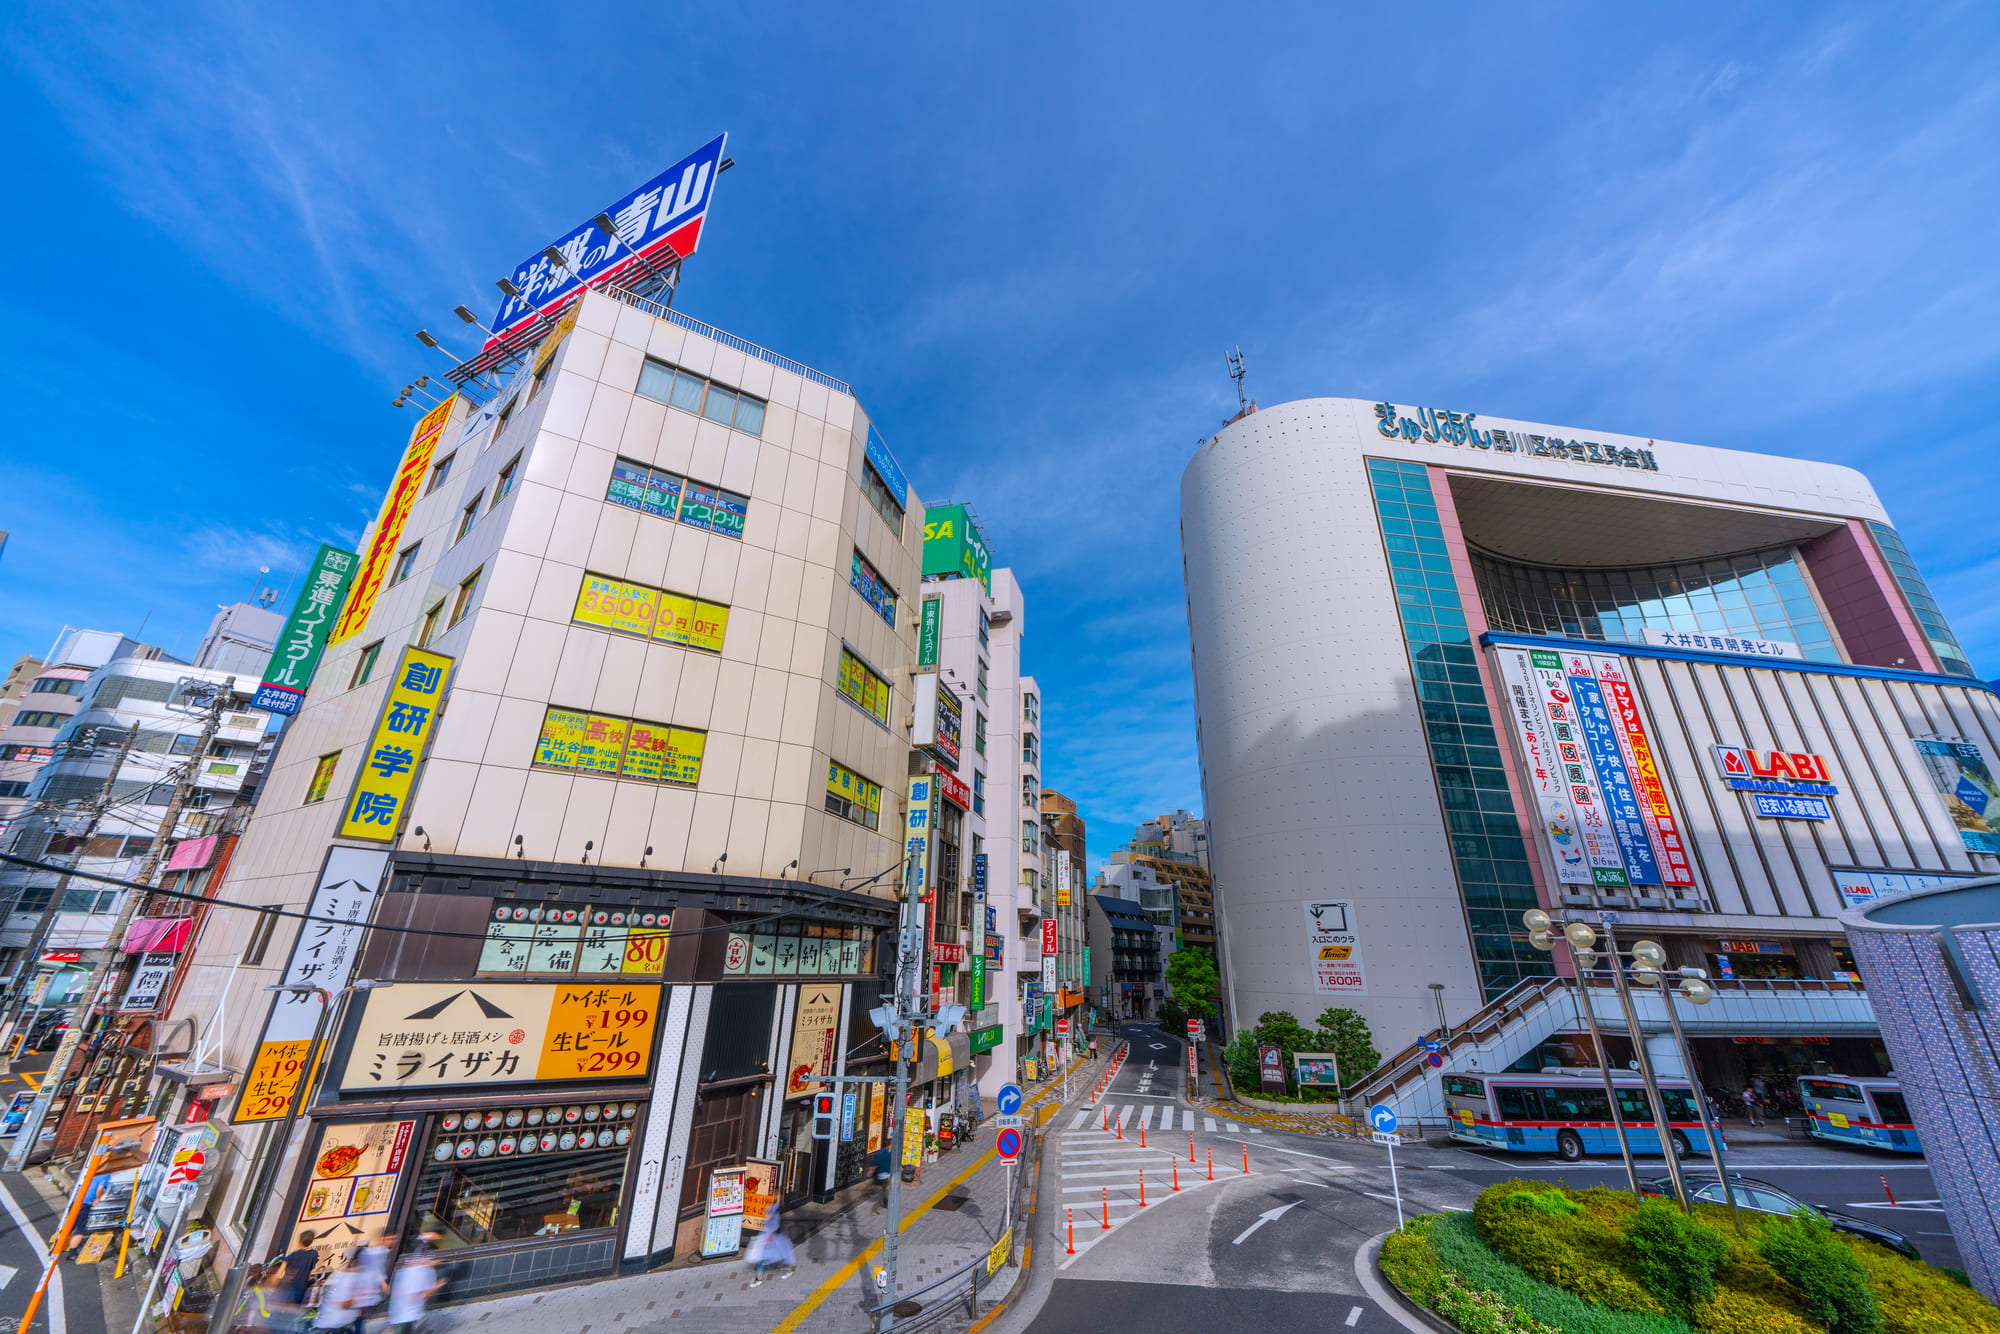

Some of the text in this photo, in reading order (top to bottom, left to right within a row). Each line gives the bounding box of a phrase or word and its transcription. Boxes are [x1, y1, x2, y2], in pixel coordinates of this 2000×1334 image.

[503, 160, 711, 320] 洋服の青山
[1375, 402, 1658, 471] きゅりあん 品川区総合区民会館
[627, 484, 744, 529] 東進ハイスクール
[354, 436, 440, 631] グランドオープン
[273, 569, 343, 686] 東進ハイスクール
[694, 619, 719, 636] OFF
[1661, 632, 1783, 655] 大井町再開発ビル
[1538, 670, 1562, 680] 11/4
[1569, 667, 1591, 677] LABI
[1600, 670, 1622, 680] LABI
[351, 661, 443, 827] 創研学院
[538, 737, 580, 754] 日比谷
[1745, 750, 1832, 782] LABI
[1574, 681, 1643, 880] トータルコーディネート提案する店
[1729, 778, 1839, 796] SHINAGAWA-OIMACHI
[1757, 797, 1828, 817] 住まいる家電館
[1849, 885, 1874, 895] LABI
[1046, 921, 1055, 953] アイフル
[1311, 935, 1355, 943] 入口このウラ
[1730, 941, 1758, 953] LABI
[626, 934, 666, 963] 80
[1323, 947, 1349, 958] Times
[974, 957, 982, 976] レイク
[1318, 975, 1363, 986] 1,600円
[561, 989, 637, 1007] ハイボール
[586, 1008, 649, 1030] ¥199
[801, 1014, 833, 1027] ミライザカ
[377, 1031, 503, 1047] 旨唐揚げと居酒メシ
[551, 1031, 630, 1052] 生ビール
[368, 1050, 520, 1082] ミライザカ
[576, 1050, 642, 1073] ¥299
